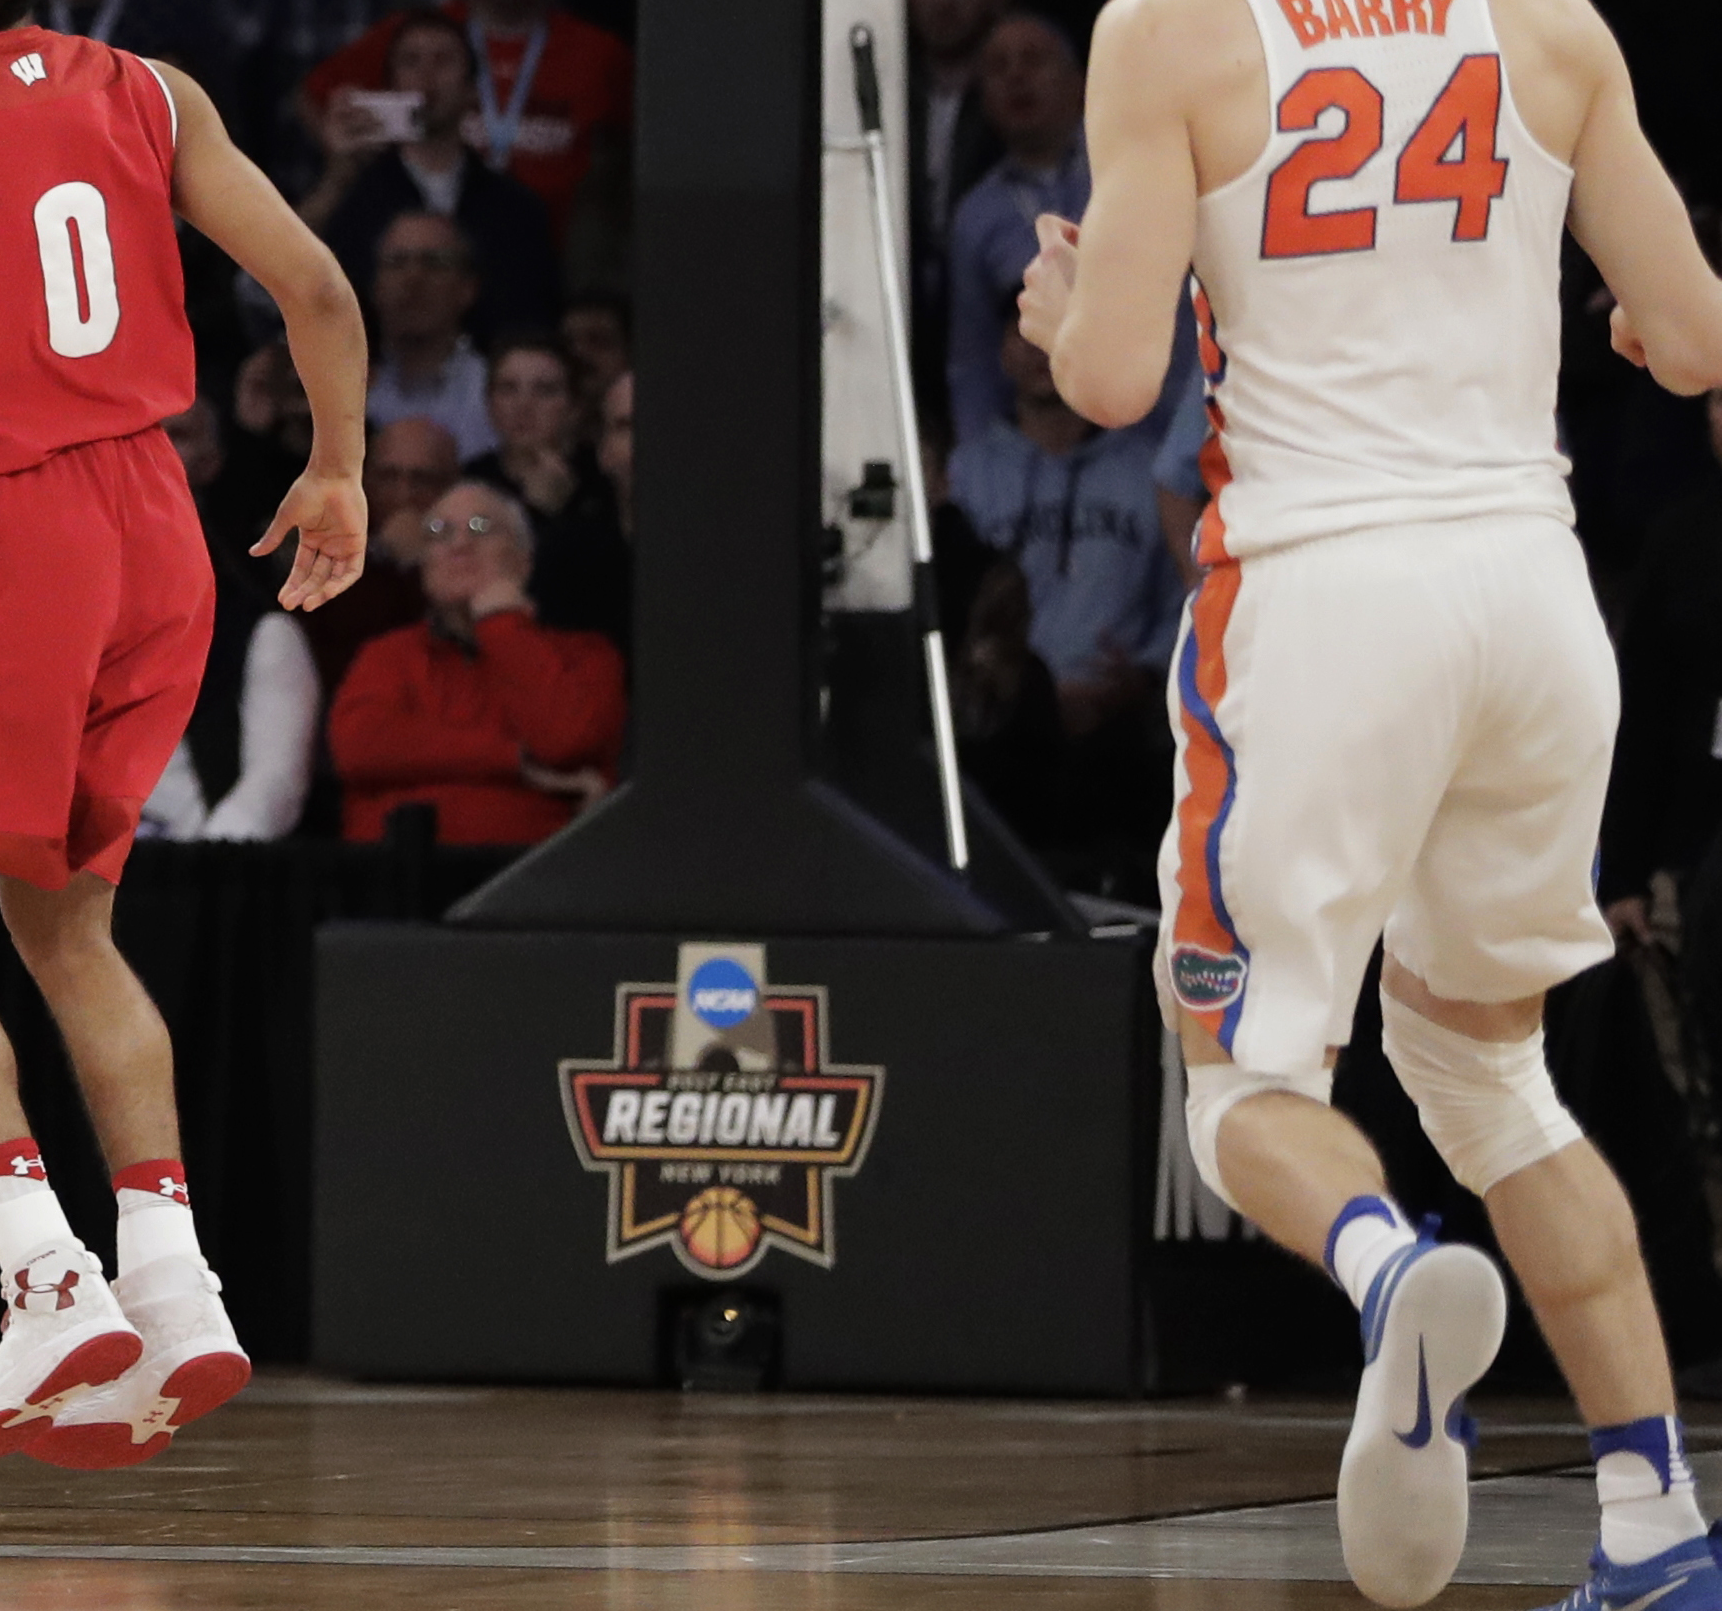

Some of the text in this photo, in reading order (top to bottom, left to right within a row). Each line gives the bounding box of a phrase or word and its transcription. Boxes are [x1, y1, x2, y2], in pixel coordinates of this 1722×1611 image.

[1258, 51, 1511, 261] 24
[33, 180, 121, 359] 0
[602, 1090, 842, 1148] REGIONAL
[659, 1163, 783, 1186] NEW YORK
